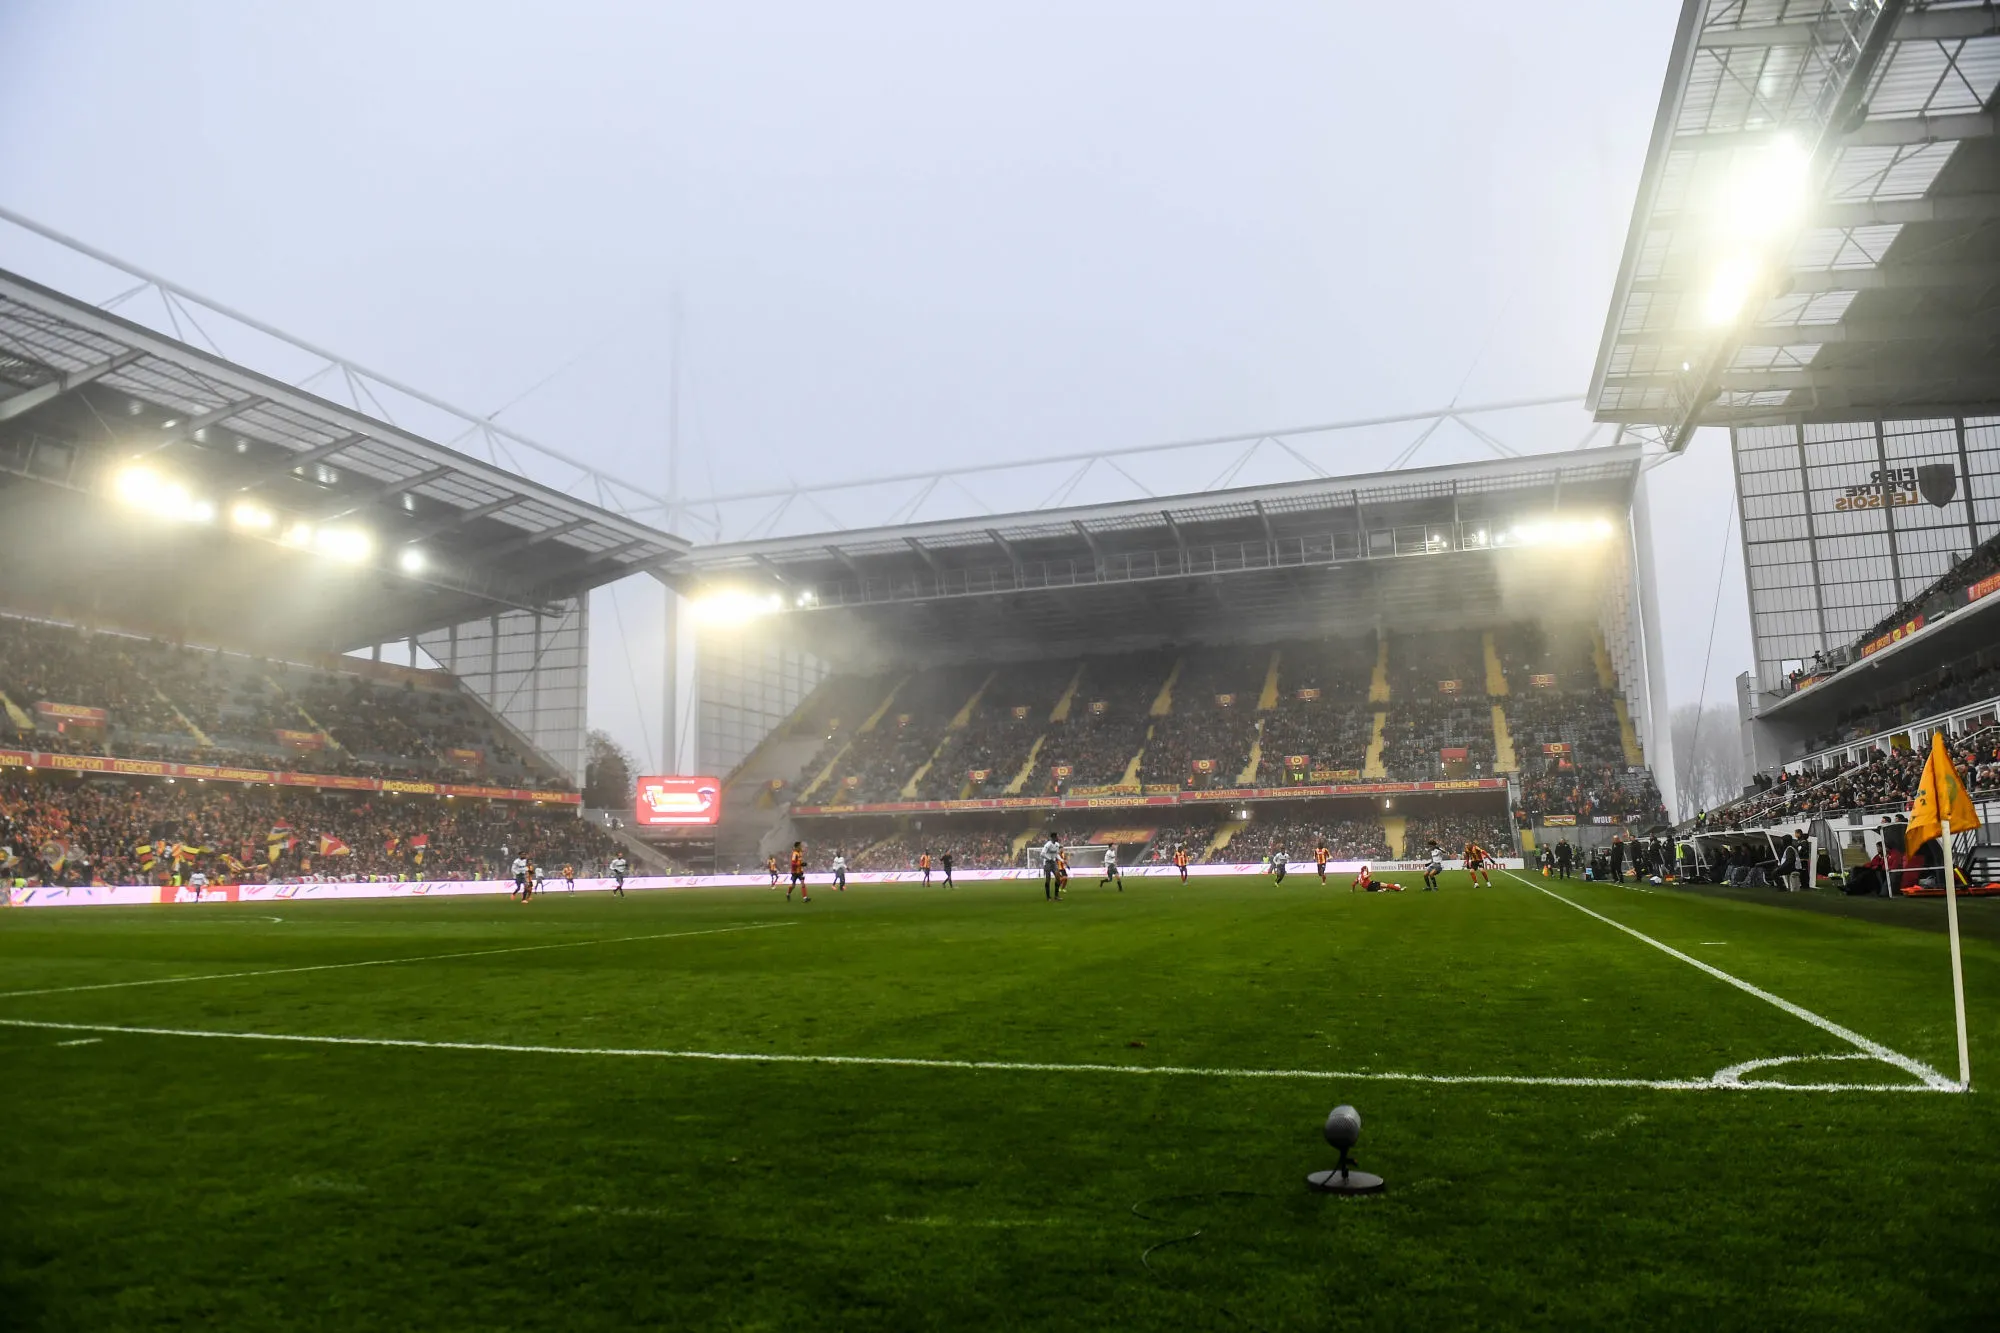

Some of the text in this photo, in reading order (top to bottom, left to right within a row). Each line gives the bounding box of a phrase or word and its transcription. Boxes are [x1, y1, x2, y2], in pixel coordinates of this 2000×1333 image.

[52, 755, 104, 769] macron
[114, 760, 162, 774] macron
[382, 781, 435, 793] McDonald's
[1434, 780, 1480, 789] RCLENS.FR
[1098, 797, 1149, 806] boulanger
